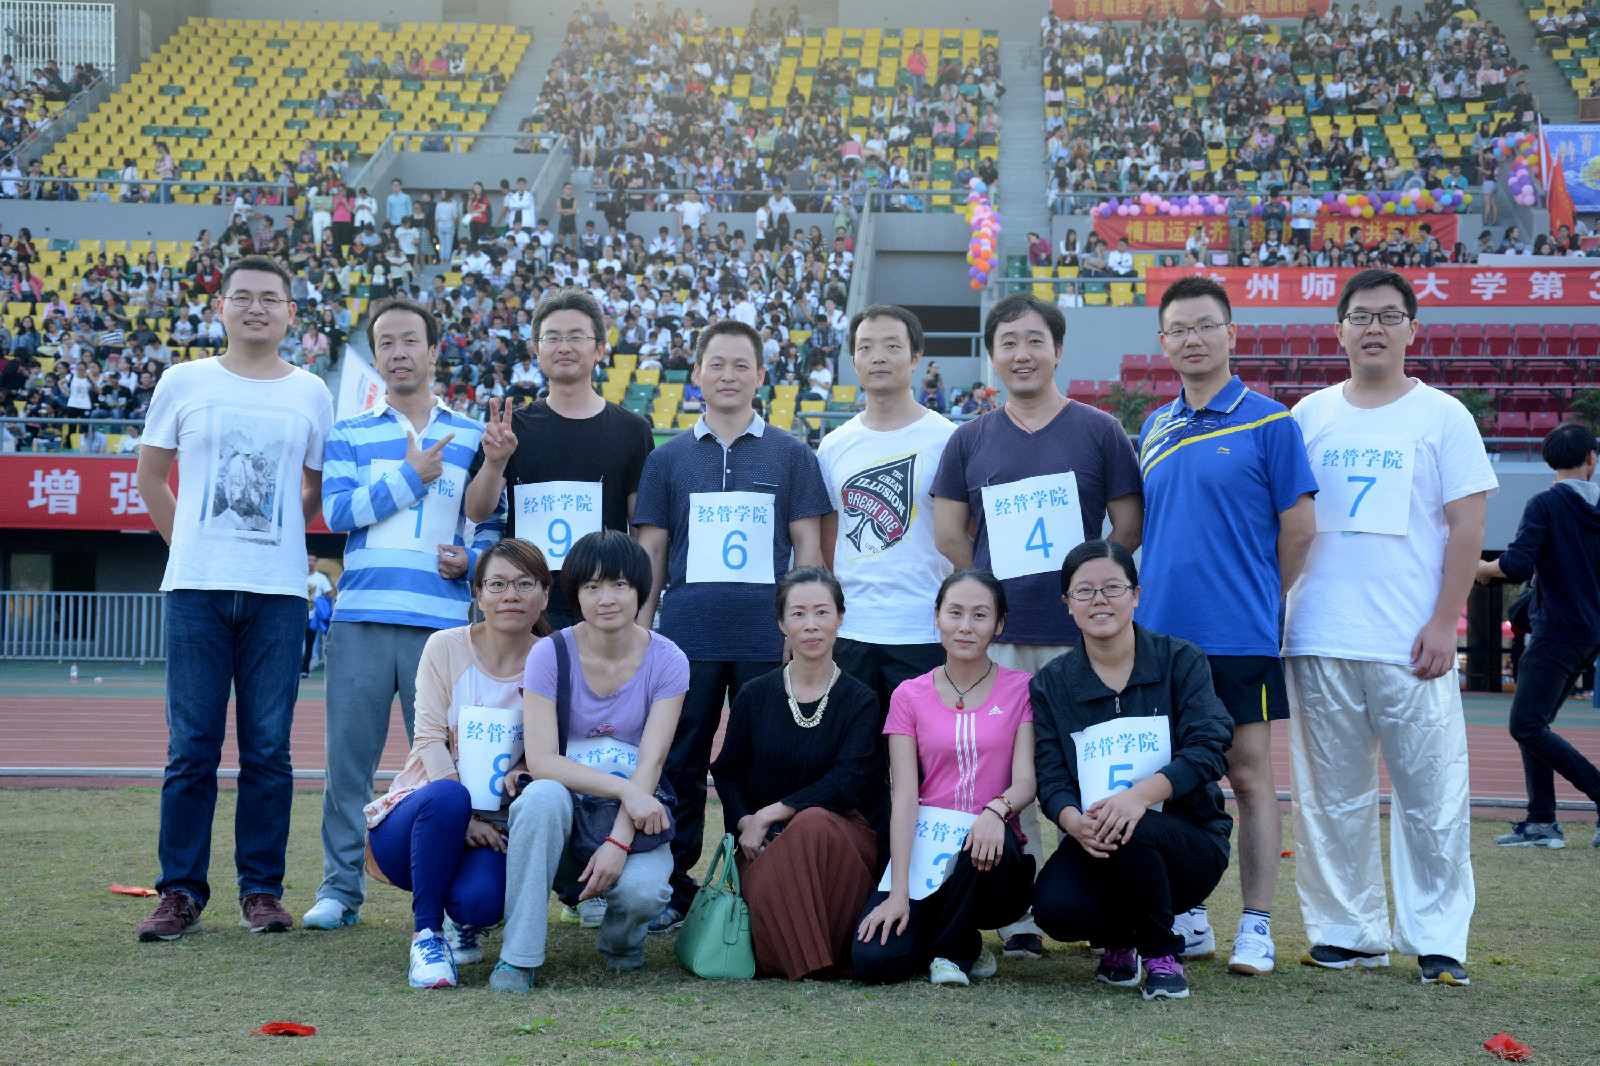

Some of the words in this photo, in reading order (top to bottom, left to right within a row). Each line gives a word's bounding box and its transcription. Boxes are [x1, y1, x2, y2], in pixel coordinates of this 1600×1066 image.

[1322, 448, 1405, 470] 经管学院
[877, 474, 904, 495] GREAT
[892, 469, 905, 481] THE
[523, 493, 594, 514] 经管学院
[854, 477, 906, 517] ILLUSION
[994, 486, 1070, 517] 经管学院
[1347, 475, 1377, 518] 7
[408, 500, 425, 539] 1
[698, 504, 769, 525] 经管学院
[547, 518, 573, 558] 9
[722, 529, 748, 570] 6
[1025, 516, 1054, 559] 4
[1083, 731, 1160, 762] 经管学院
